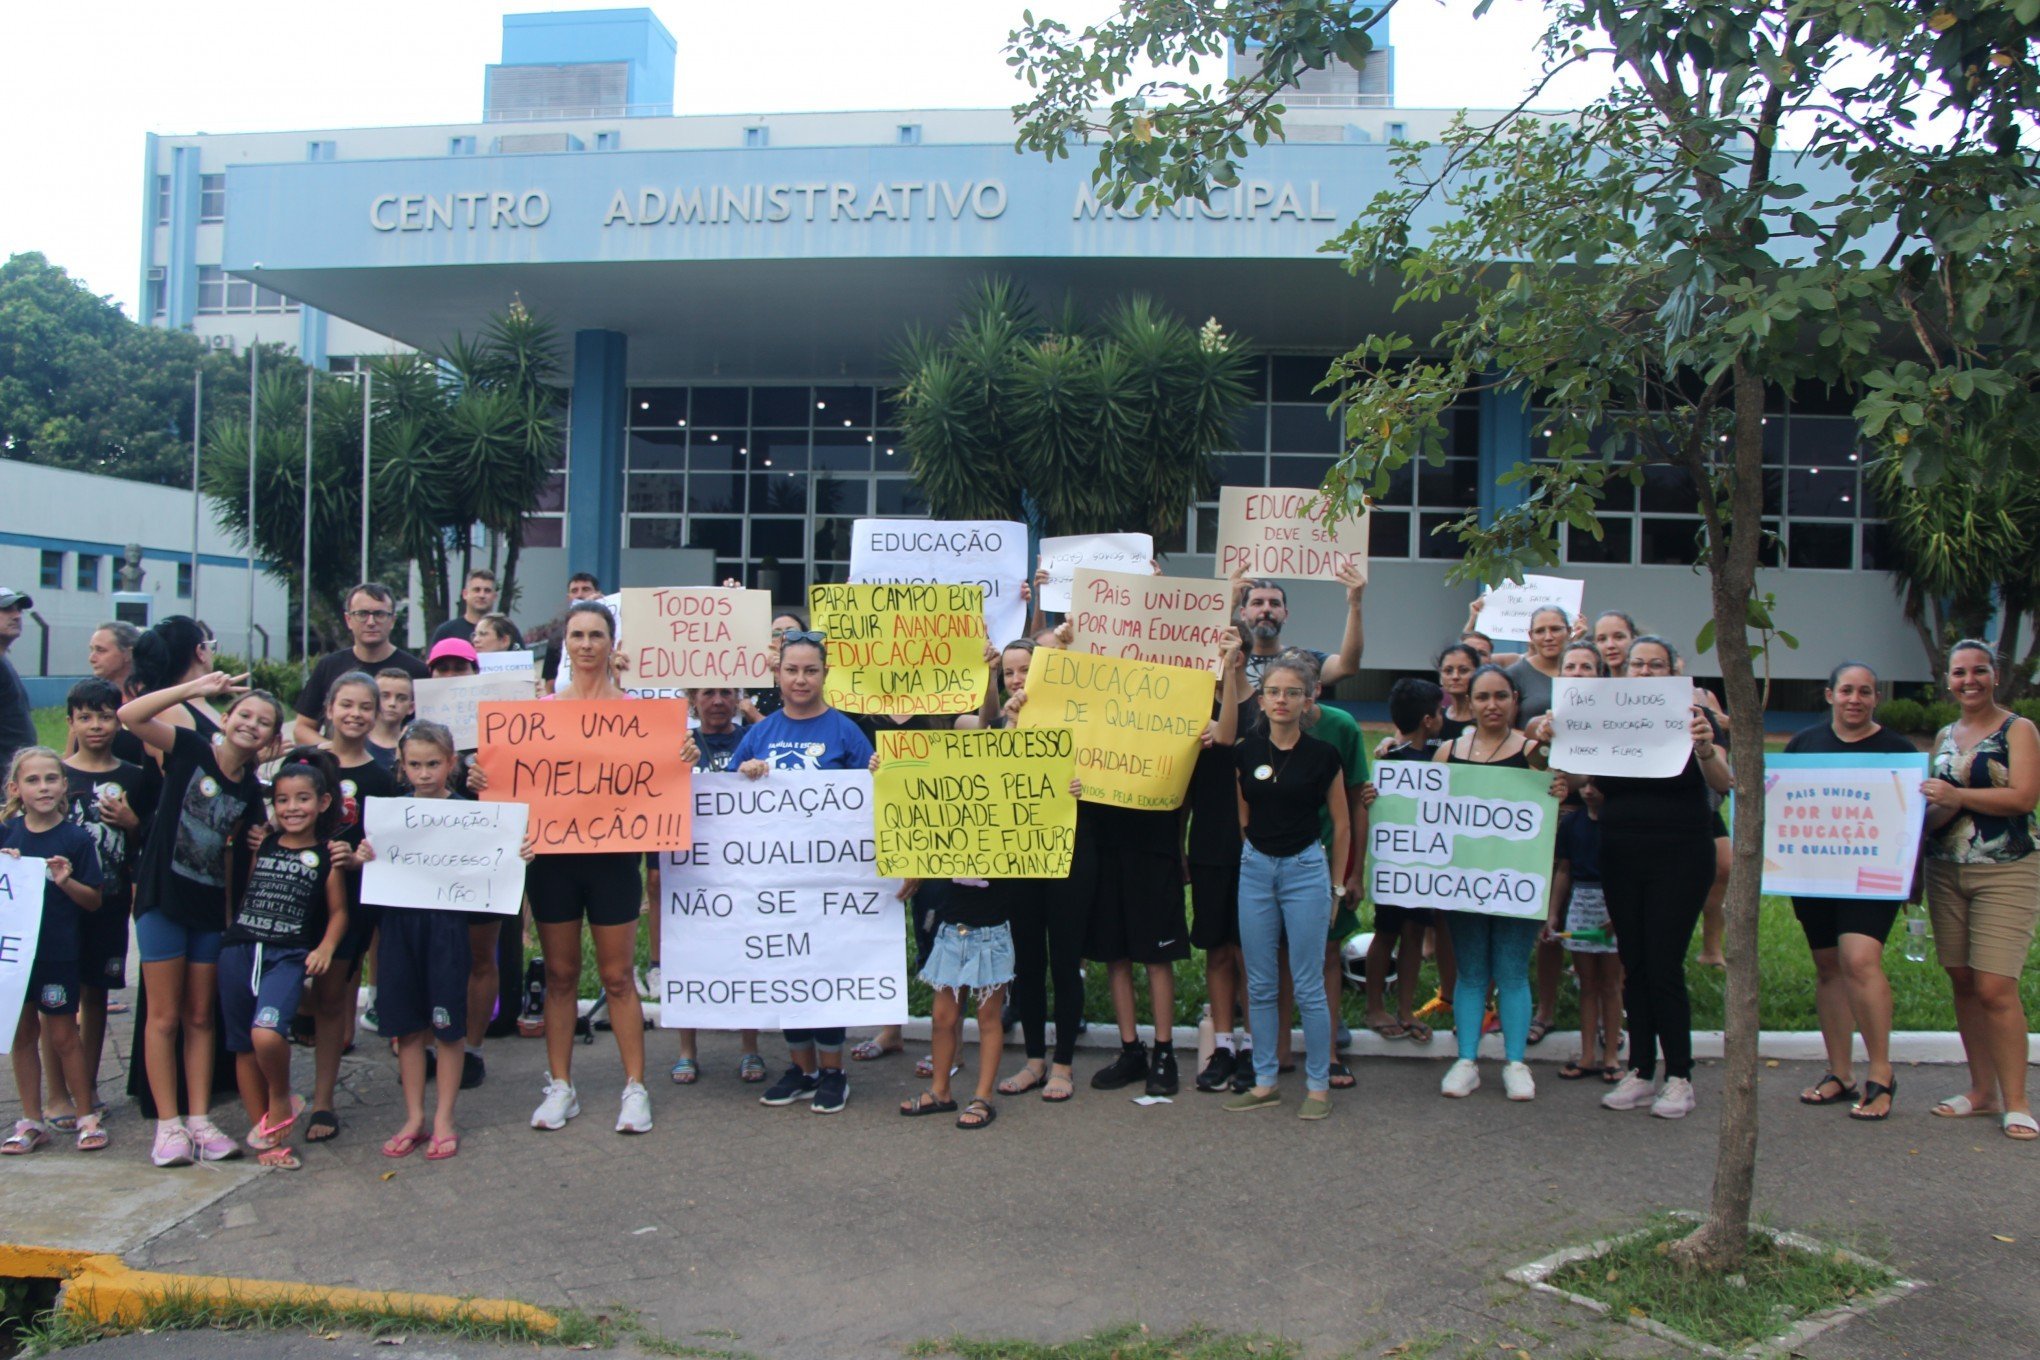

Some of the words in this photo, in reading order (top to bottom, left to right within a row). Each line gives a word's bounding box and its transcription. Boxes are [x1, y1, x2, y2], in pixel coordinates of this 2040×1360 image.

[369, 189, 551, 231] CENTRO
[603, 178, 1008, 227] ADMINISTRATIVO
[871, 529, 1003, 556] EDUCAÇÃO
[1264, 526, 1300, 541] DEVE
[1311, 528, 1339, 544] SER
[1223, 543, 1362, 576] PRIORIDADE
[653, 590, 732, 617] TODOS
[811, 586, 858, 612] PARA
[871, 585, 938, 612] CAMPO
[949, 585, 984, 613] BOM
[670, 620, 731, 643] PELA
[818, 613, 883, 640] SEGUIR
[893, 613, 987, 640] AVANÇANDO
[1077, 611, 1108, 635] POR
[1112, 617, 1142, 639] UMA
[638, 646, 769, 681] EDUCAÇÃO
[824, 638, 951, 669] EDUCAÇÃO
[880, 669, 925, 694] UMA
[933, 668, 975, 694] DAS
[1043, 653, 1170, 702] EDUCAÇÃO
[829, 689, 978, 714] PRIORIDADES!
[1615, 691, 1666, 707] UNIDOS
[486, 712, 555, 744] POR
[581, 712, 648, 738] UMA
[1064, 699, 1089, 723] DE
[1105, 699, 1201, 737] QUALIDADE
[1566, 719, 1592, 731] PELA
[1602, 718, 1654, 732] EDUCAÇÃO
[1665, 719, 1685, 730] DOS
[882, 731, 929, 760] NÃO
[944, 729, 1072, 759] RETROCESSO
[1074, 747, 1174, 780] IORIDADE!!!
[513, 758, 662, 798] MELHOR
[904, 774, 990, 801] UNIDOS
[1000, 772, 1055, 800] PELA
[1378, 767, 1443, 791] PAIS
[695, 783, 864, 817] EDUCAÇÃO
[1081, 784, 1106, 798] NIDOS
[1113, 789, 1133, 803] PELA
[1787, 788, 1816, 801] PAIS
[1822, 787, 1871, 801] UNIDOS
[884, 802, 1000, 829] QUALIDADE
[1013, 802, 1044, 826] DE
[1423, 801, 1534, 832] UNIDOS
[1784, 805, 1820, 820] POR
[1831, 806, 1875, 820] UMA
[527, 807, 682, 847] UCAÇÃO!!!
[880, 827, 969, 853] ENSINO
[978, 829, 991, 851] E
[1000, 825, 1075, 852] FUTURO
[1777, 821, 1880, 844] EDUCAÇÃO
[671, 842, 710, 865] DE
[723, 839, 877, 865] QUALIDAD
[1375, 829, 1449, 854] PELA
[1778, 844, 1795, 854] DE
[1801, 845, 1879, 857] QUALIDADE
[876, 853, 909, 877] DAS
[916, 852, 990, 876] NOSSAS
[993, 851, 1073, 876] CRIANÇAS
[1376, 871, 1536, 906] EDUCAÇÃO
[671, 888, 733, 917] NÃO
[757, 890, 797, 915] SE
[823, 892, 880, 915] FAZ
[745, 932, 811, 959] SEM
[667, 976, 897, 1003] PROFESSORES
